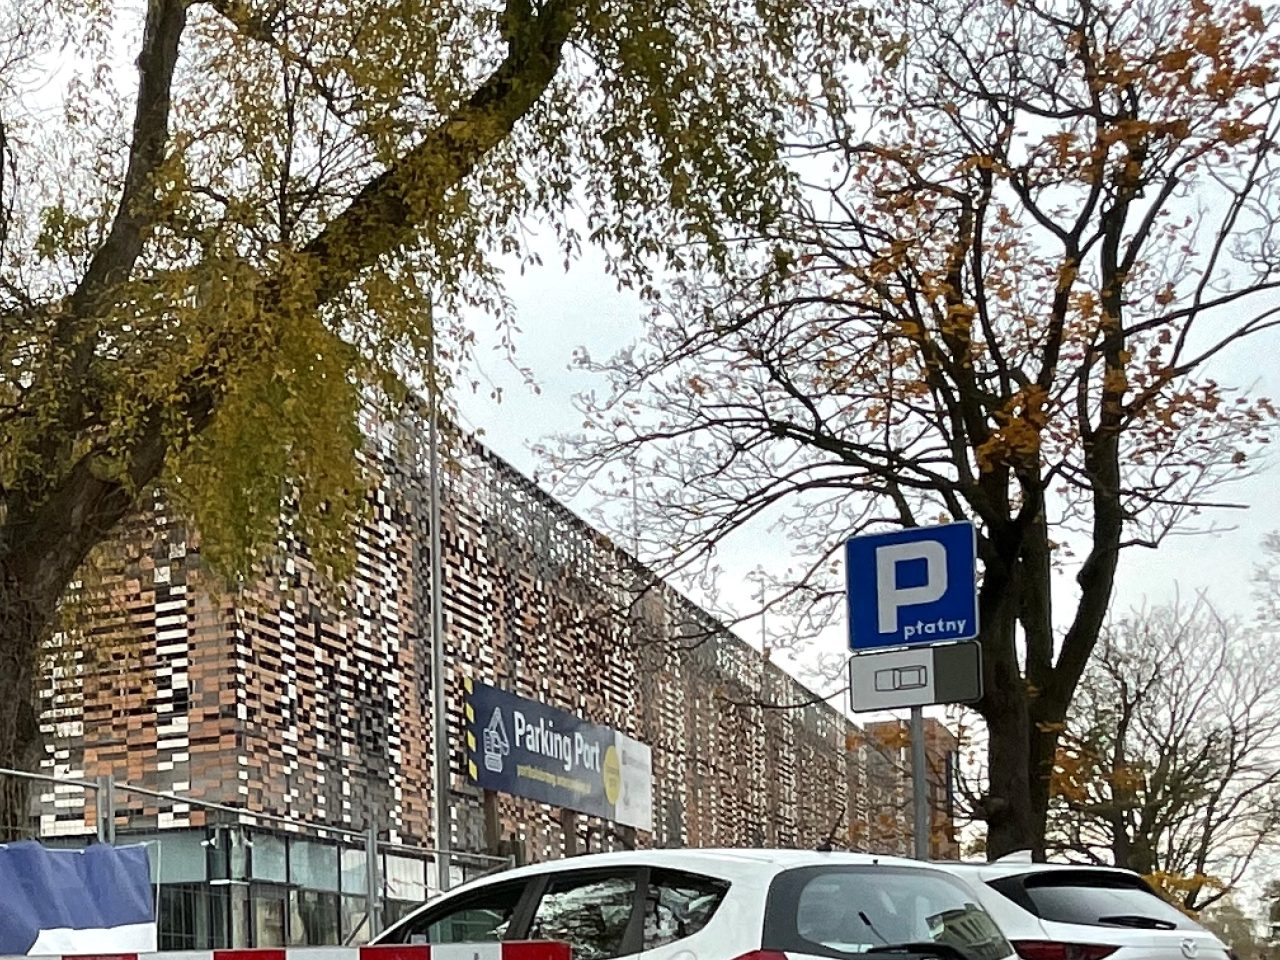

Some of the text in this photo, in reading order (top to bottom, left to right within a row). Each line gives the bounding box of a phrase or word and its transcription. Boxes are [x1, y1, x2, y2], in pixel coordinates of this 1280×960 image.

[876, 539, 949, 634] P
[903, 617, 967, 640] płatny
[513, 710, 572, 771] Parking
[574, 731, 601, 773] Port
